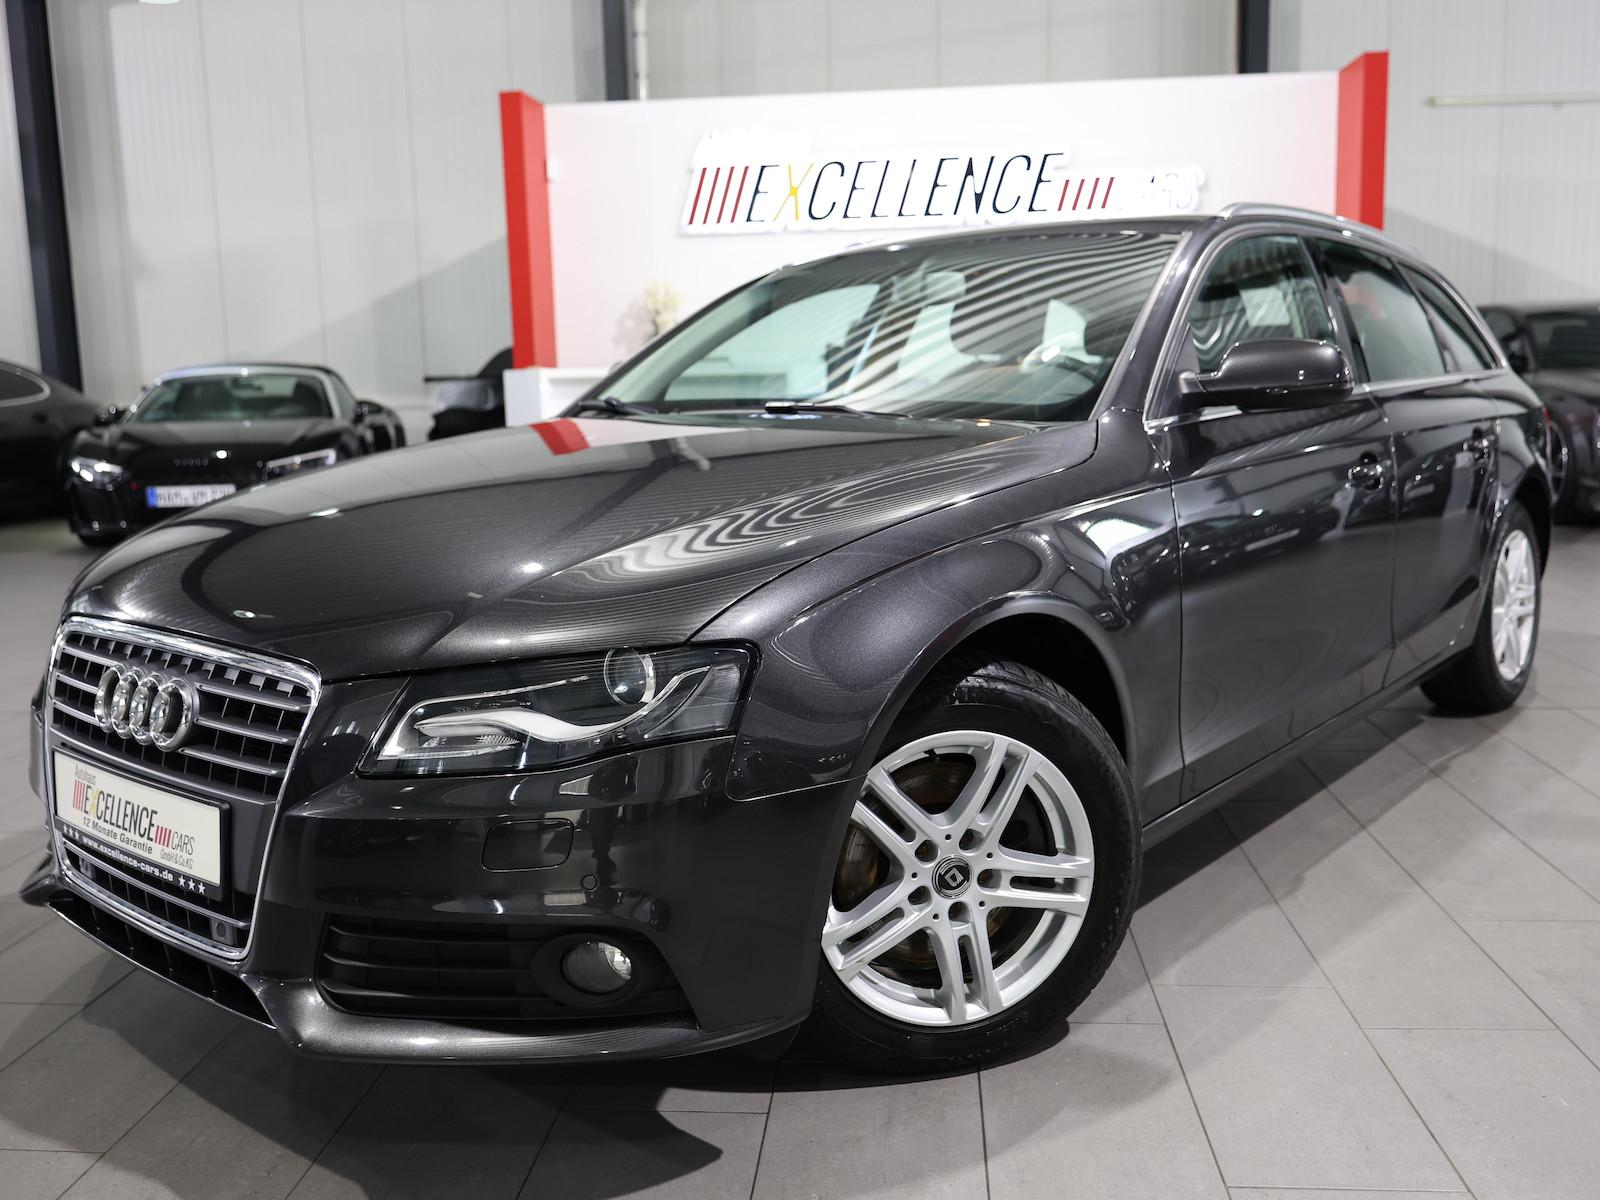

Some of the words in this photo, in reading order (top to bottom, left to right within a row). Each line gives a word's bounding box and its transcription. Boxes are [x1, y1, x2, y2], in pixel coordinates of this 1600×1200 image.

[746, 152, 1065, 223] EXCELLENCE
[74, 765, 96, 785] Autohaus
[82, 816, 91, 828] 12
[91, 821, 118, 841] Monate
[119, 833, 153, 855] Garantie
[83, 785, 158, 842] EXCELLENCE
[171, 831, 196, 856] CARS
[82, 835, 174, 882] www.excellence-cars.de
